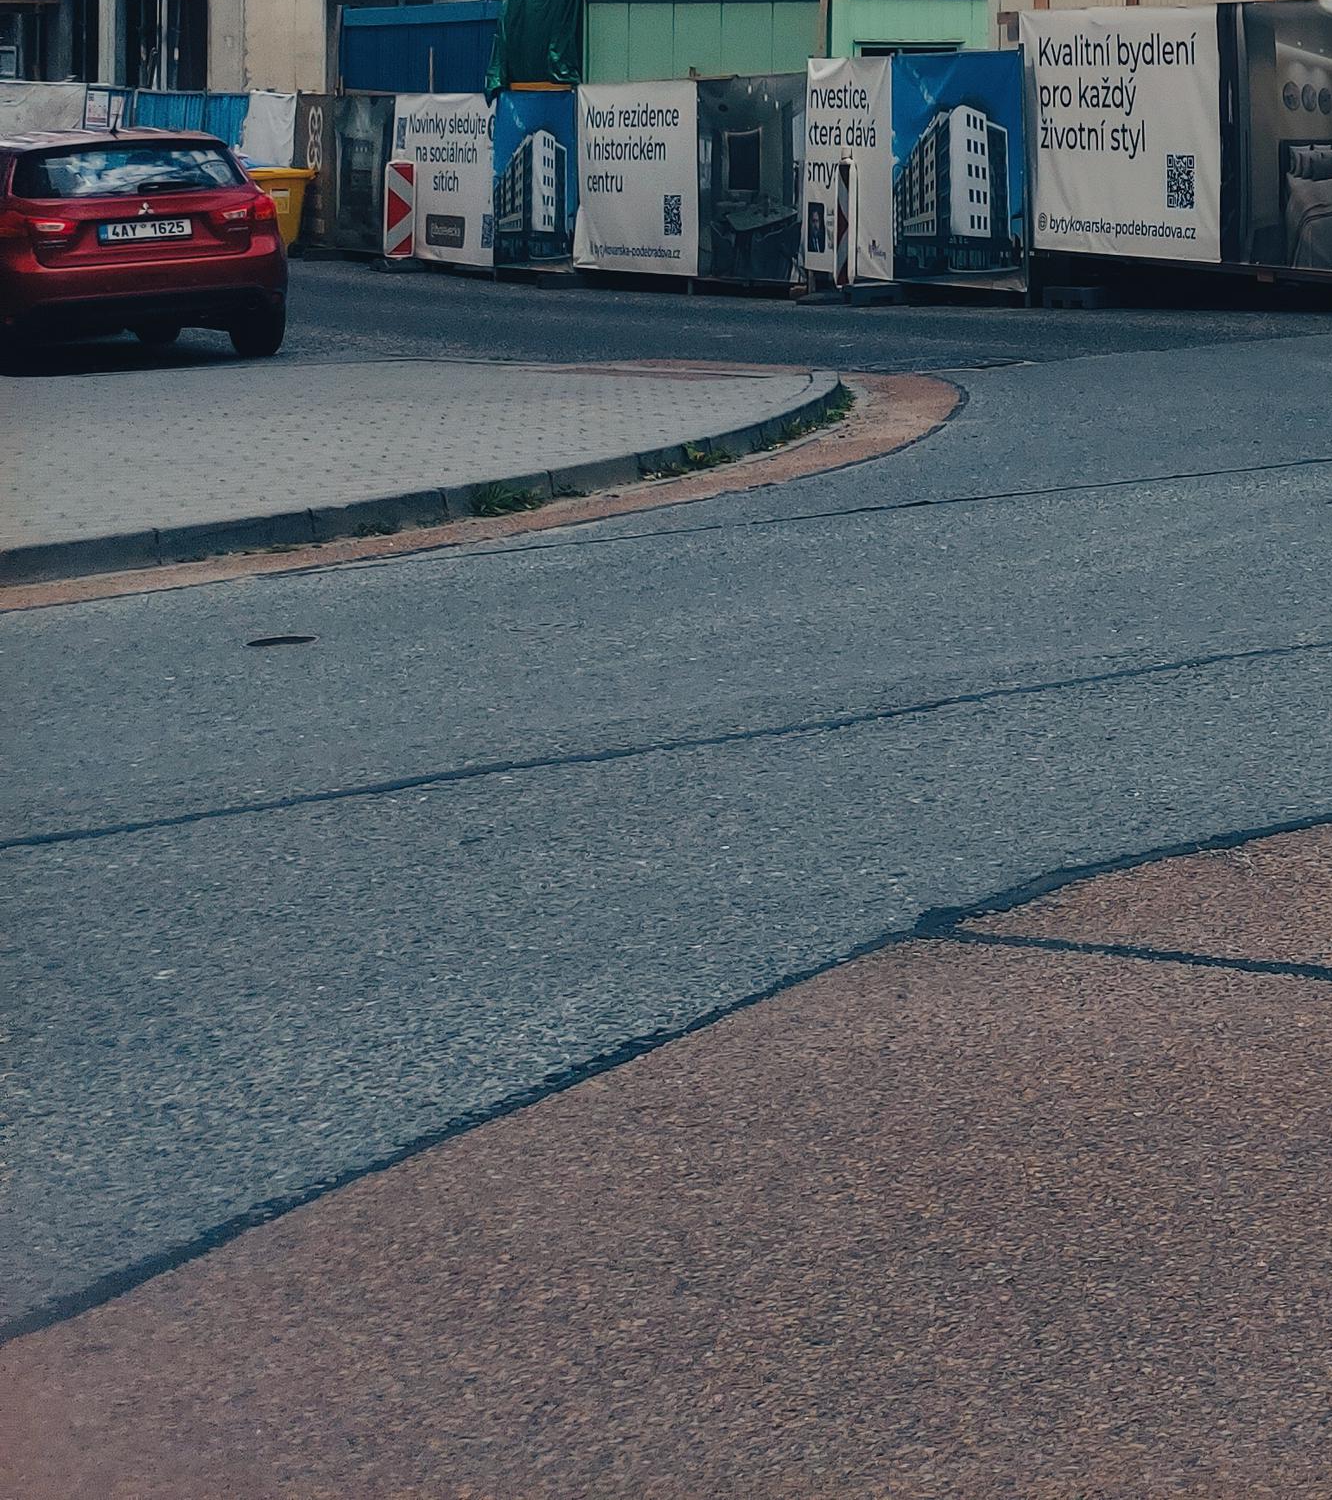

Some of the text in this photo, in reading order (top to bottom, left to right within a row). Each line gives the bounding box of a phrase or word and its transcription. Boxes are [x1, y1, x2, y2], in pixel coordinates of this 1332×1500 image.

[1039, 32, 1196, 73] Kvalitní bydlení
[810, 81, 870, 114] nvestice,
[1040, 77, 1136, 116] pro každý
[409, 113, 486, 140] Novinky sledujte
[586, 103, 679, 128] Nová rezidence
[846, 119, 876, 147] dává
[1041, 118, 1146, 160] životní styl
[416, 142, 477, 164] na sociálních
[586, 135, 666, 161] v historickém
[433, 171, 459, 192] sítích
[587, 171, 623, 193] centru
[112, 223, 137, 238] 4AY
[151, 221, 185, 235] 1625
[1050, 214, 1196, 239] bytykovarska-podebradova.cz
